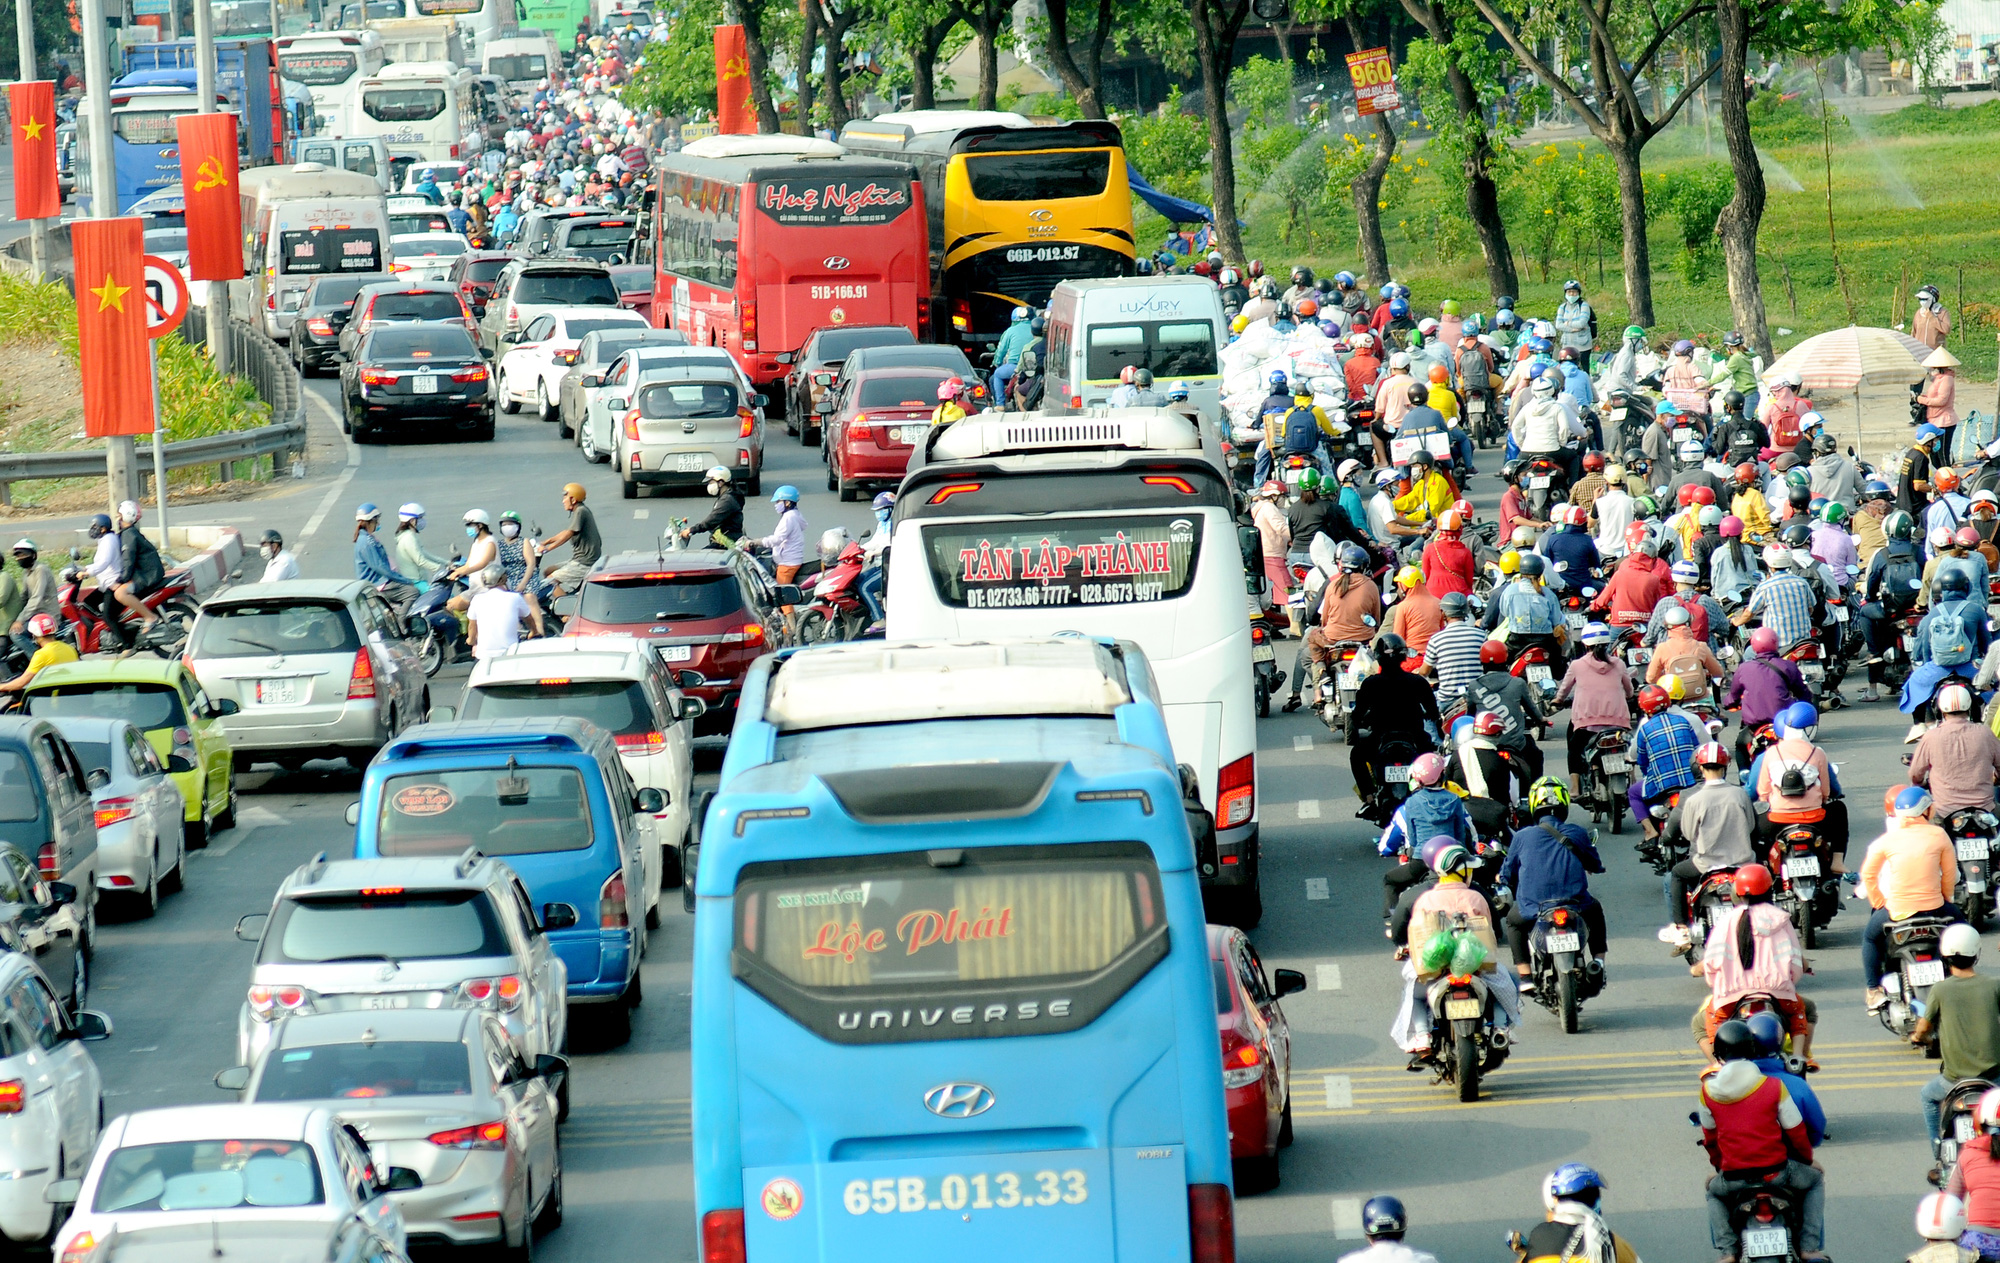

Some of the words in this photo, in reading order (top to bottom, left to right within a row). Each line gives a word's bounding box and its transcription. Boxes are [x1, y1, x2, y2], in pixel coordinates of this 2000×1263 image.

[1352, 59, 1392, 88] 960
[765, 184, 819, 211] Huệ
[822, 183, 905, 216] Nghĩa
[1006, 246, 1081, 263] 66B-012.87
[811, 284, 868, 300] 51B-166.91
[1119, 291, 1180, 316] LUXURY
[1158, 309, 1184, 318] Cars
[683, 454, 696, 463] 51F
[959, 538, 1013, 582] TÂN
[1020, 537, 1072, 587] LẬP
[1076, 530, 1172, 578] THÀNH
[967, 590, 985, 608] ĐT:
[986, 586, 1038, 607] 02733.66
[1042, 584, 1071, 604] 7777
[1080, 582, 1133, 604] 028.6673
[1135, 581, 1163, 601] 9977
[777, 892, 801, 909] XE
[804, 888, 865, 907] KHÁCH
[802, 920, 887, 964] Lộc
[896, 907, 1016, 957] Phát
[837, 998, 1072, 1030] UNIVERSE
[1137, 1149, 1173, 1160] NOBLE
[1749, 1243, 1784, 1256] 010.97
